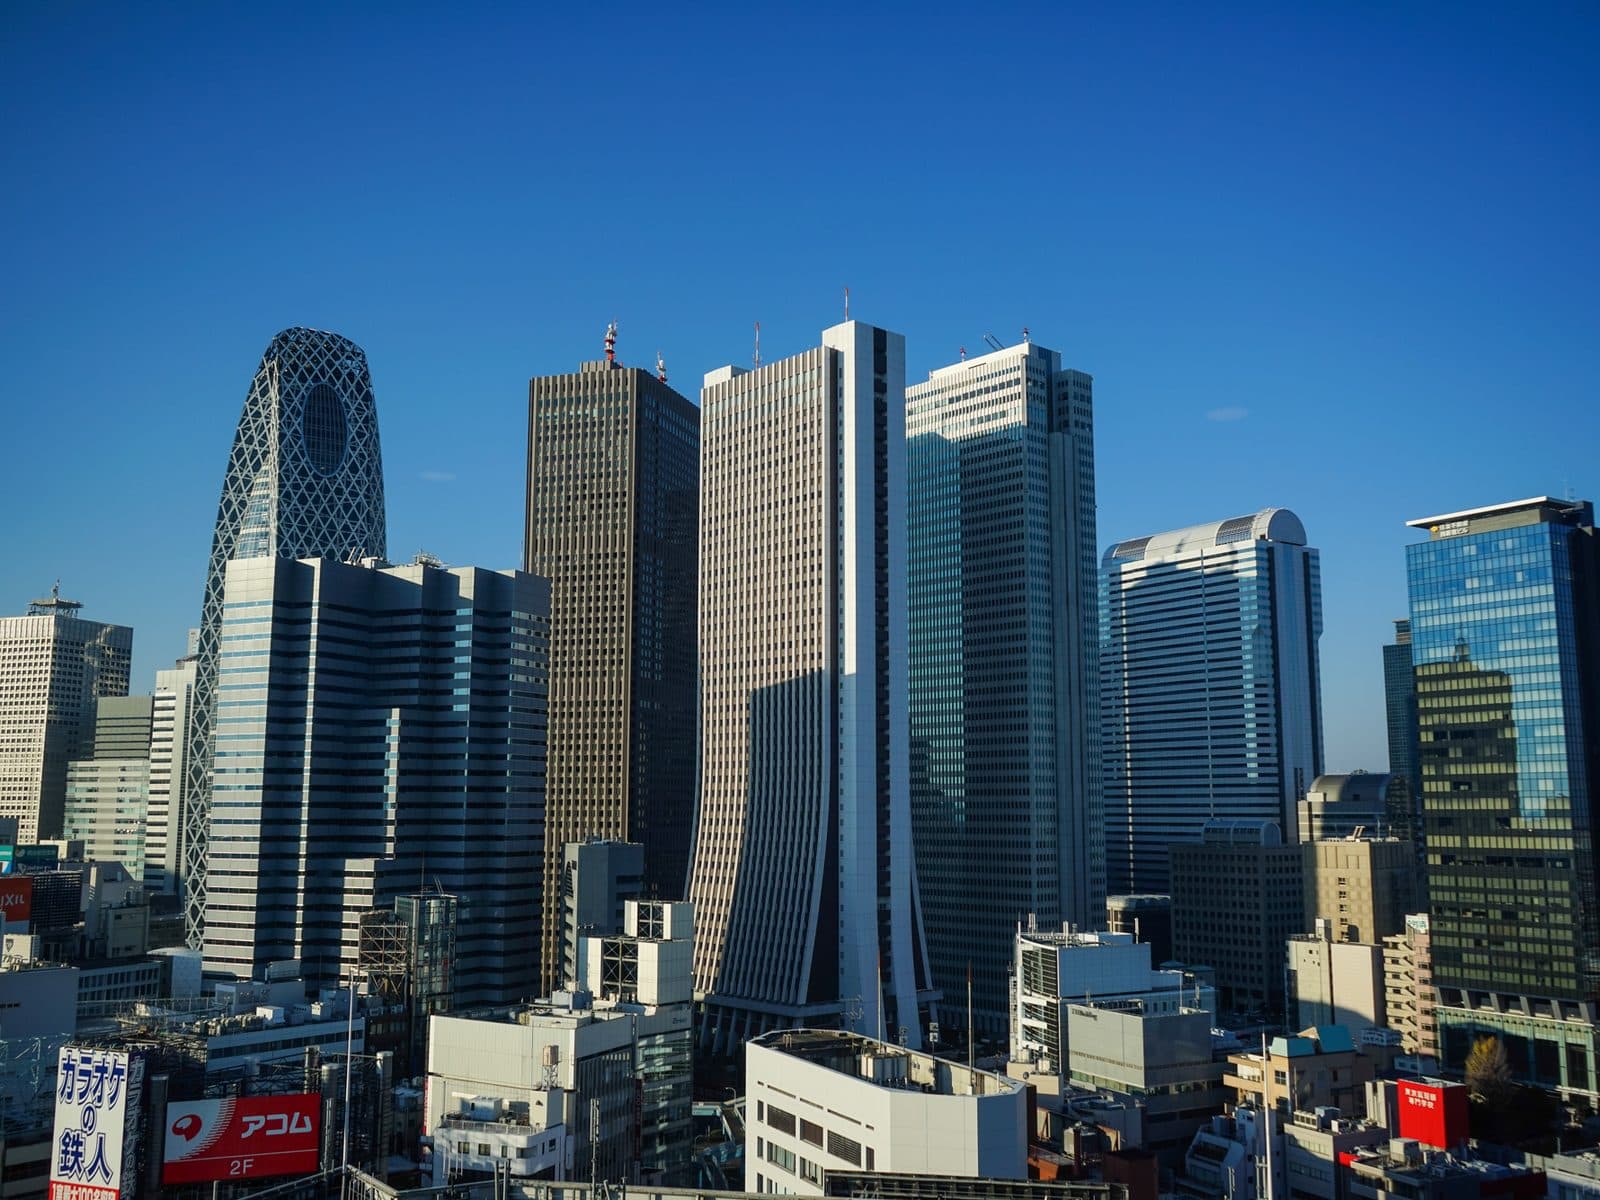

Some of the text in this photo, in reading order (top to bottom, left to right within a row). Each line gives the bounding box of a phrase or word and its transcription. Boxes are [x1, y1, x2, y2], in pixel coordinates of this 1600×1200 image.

[58, 1050, 126, 1110] カラオケ
[81, 1103, 97, 1136] の
[240, 1111, 313, 1139] アコム
[58, 1128, 114, 1184] 鉄人
[230, 1158, 255, 1176] 2F
